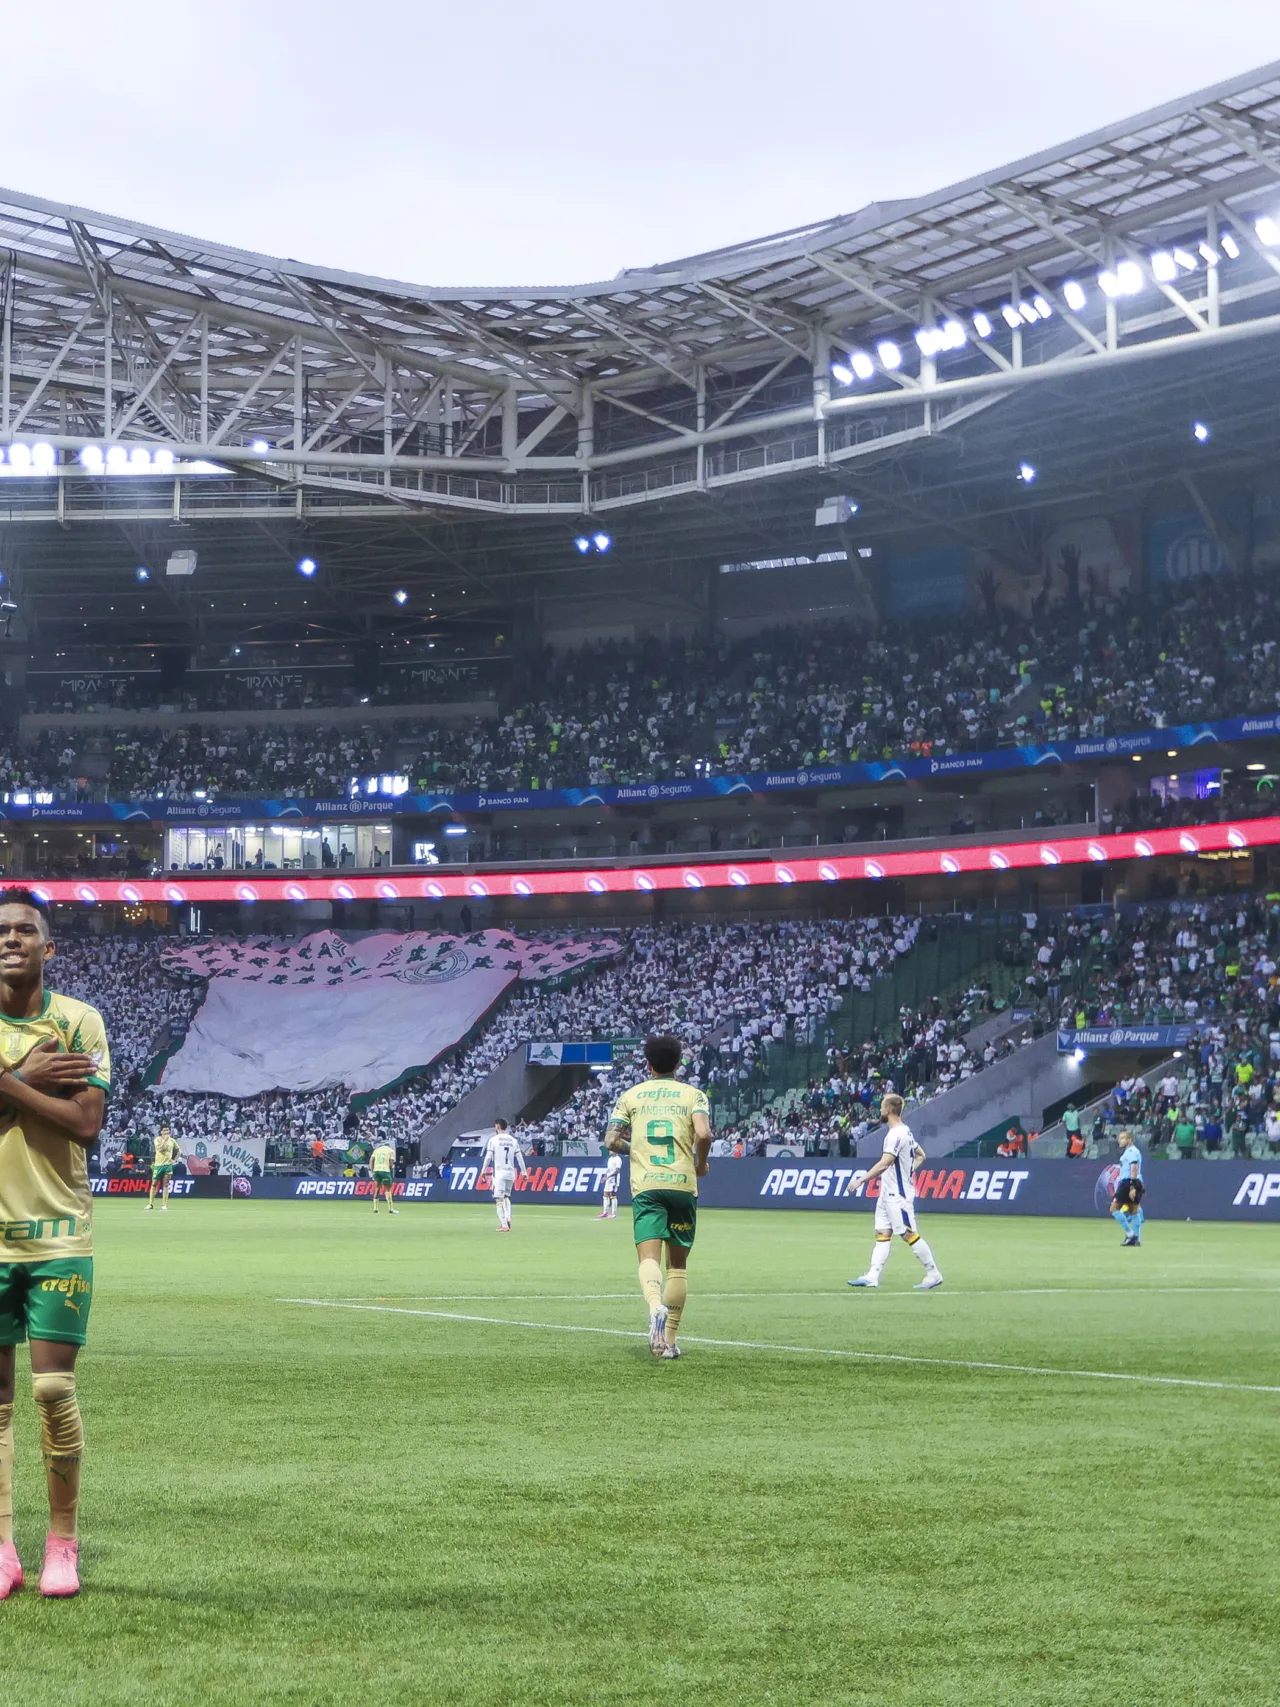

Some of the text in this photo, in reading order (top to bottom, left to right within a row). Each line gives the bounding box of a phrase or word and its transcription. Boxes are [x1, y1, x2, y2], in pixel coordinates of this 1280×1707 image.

[236, 675, 303, 689] MIRANTE
[410, 667, 479, 683] MIRANTE
[1242, 720, 1274, 732] Allianz
[1075, 736, 1151, 755] Allianz Seguros
[940, 759, 983, 770] BANCO PAN
[766, 771, 842, 786] Allianz Seguros
[617, 785, 692, 799] Allianz Seguros
[315, 800, 394, 814] Allianz Parque
[487, 796, 529, 805] BANCO PAN
[41, 808, 84, 816] BANCO PAN
[166, 805, 242, 818] Allianz Seguros
[1073, 1030, 1109, 1044] Allianz
[1124, 1031, 1159, 1044] Parque
[636, 1087, 681, 1101] crefisa
[646, 1119, 676, 1166] 9
[503, 1146, 511, 1165] 7
[450, 1166, 608, 1193] TAGNHA.BET
[760, 1168, 1030, 1201] APOSTAGNHA.BET
